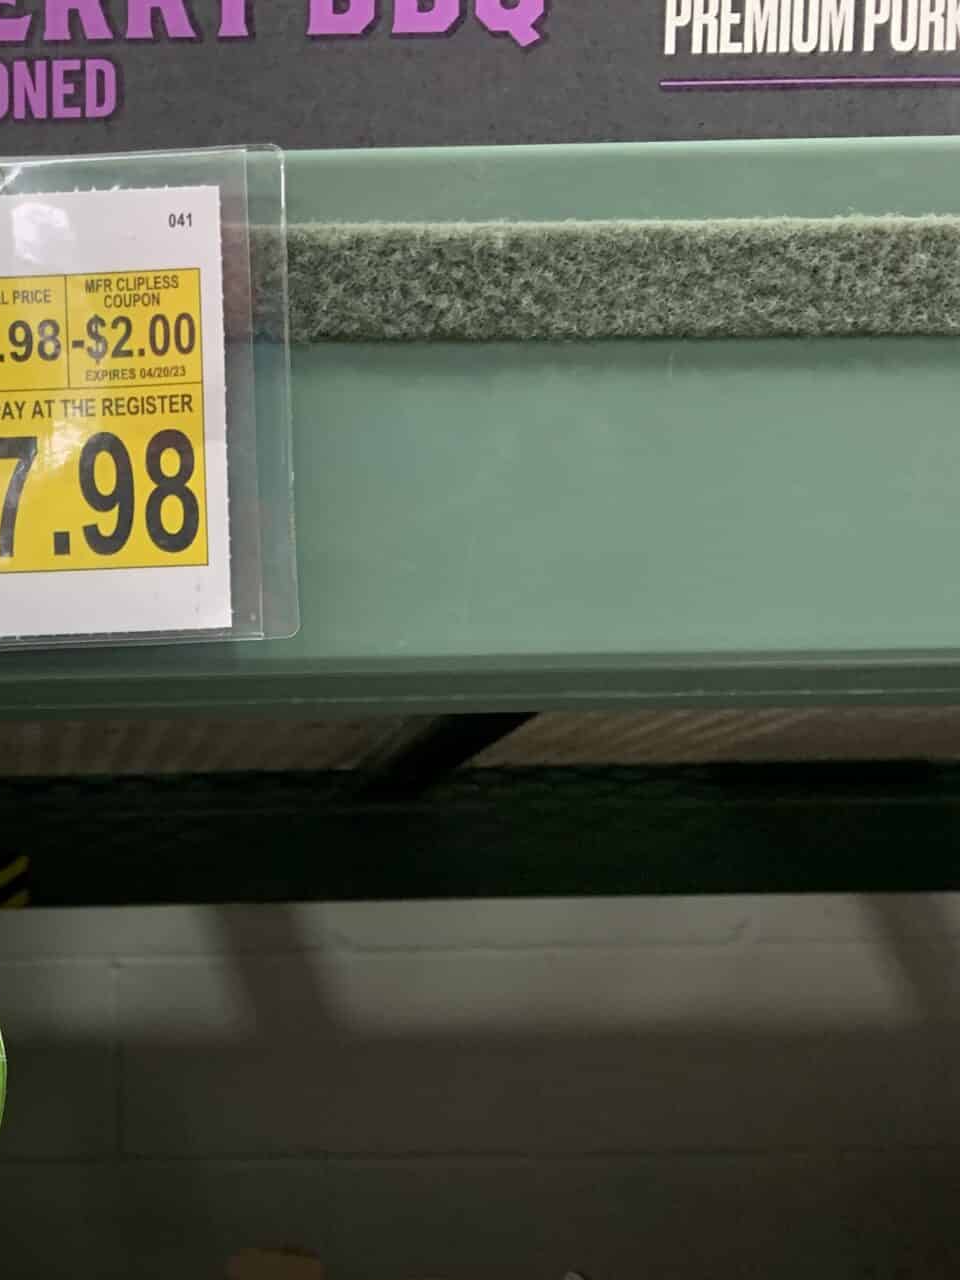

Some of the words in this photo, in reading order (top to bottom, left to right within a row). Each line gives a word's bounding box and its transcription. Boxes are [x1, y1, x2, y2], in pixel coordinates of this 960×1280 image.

[663, 0, 855, 55] PREMIUM
[168, 213, 193, 228] 041
[85, 277, 113, 293] MFR
[116, 275, 179, 291] CLIPLESS
[12, 288, 53, 305] PRICE
[104, 292, 160, 309] COUPON
[71, 312, 196, 365] -$2.00
[85, 367, 136, 382] EXPIRES
[139, 365, 186, 380] 04/20/23
[31, 399, 56, 419] AT
[60, 398, 96, 418] THE
[101, 394, 193, 416] REGISTER
